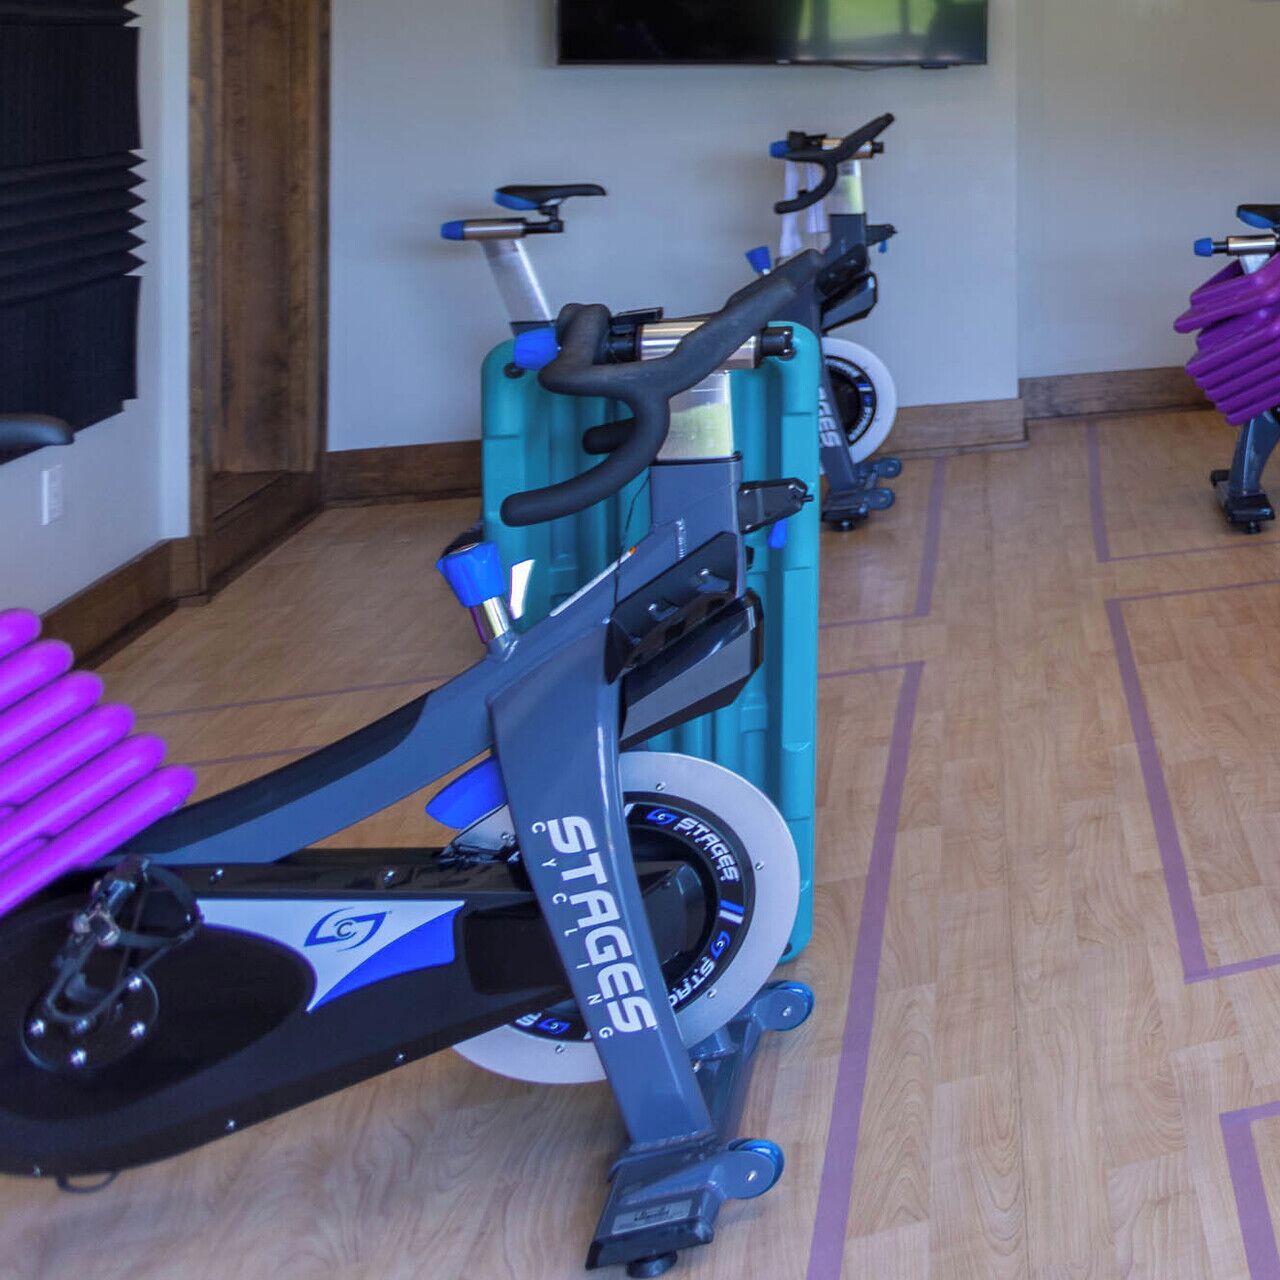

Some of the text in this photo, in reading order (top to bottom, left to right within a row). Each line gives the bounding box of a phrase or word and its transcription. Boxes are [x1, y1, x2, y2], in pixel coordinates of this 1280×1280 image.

[532, 822, 614, 1039] CYCLING
[547, 816, 658, 1033] STAGES
[673, 817, 740, 882] STAGES
